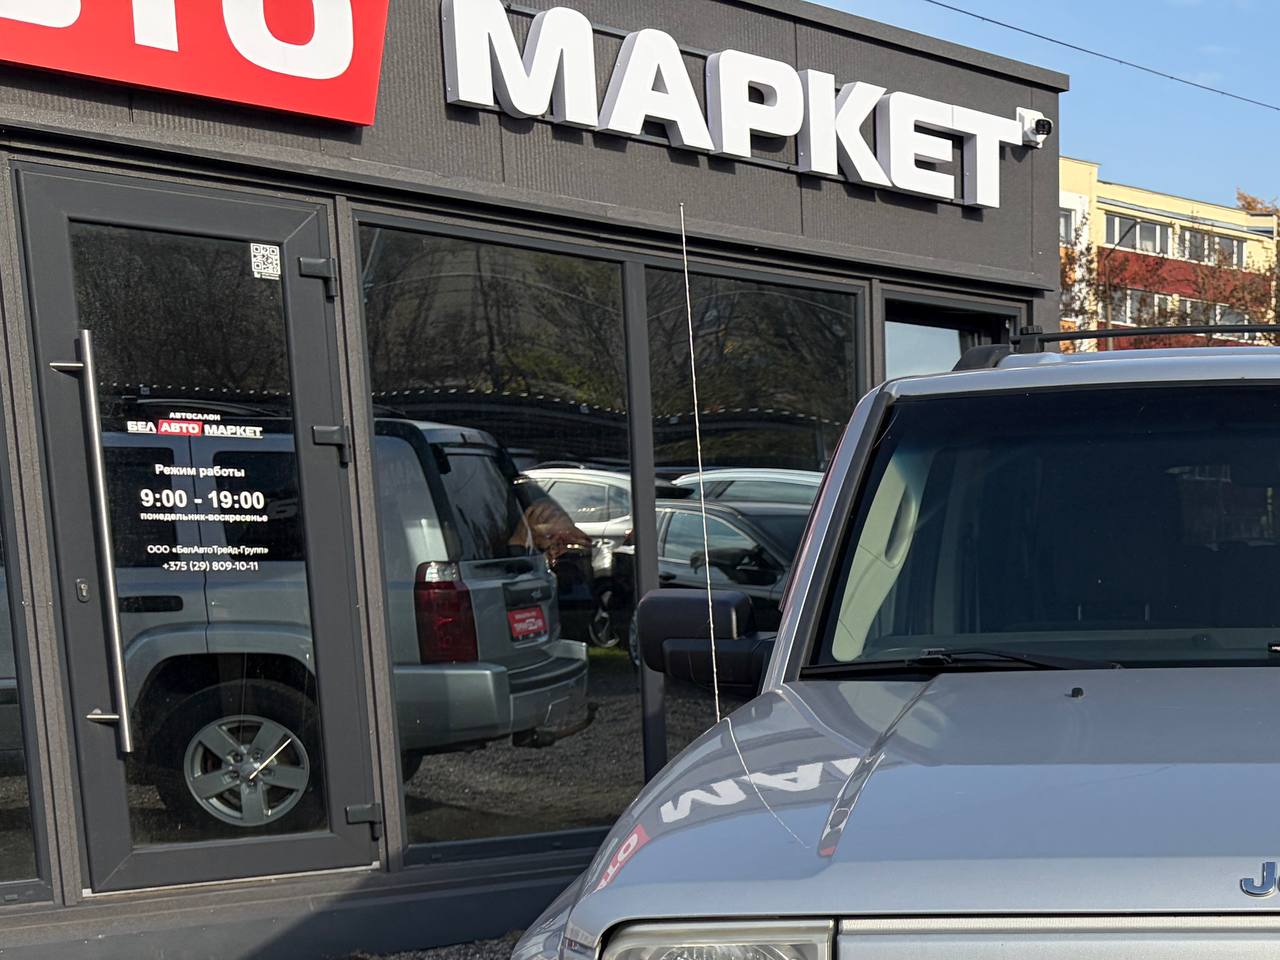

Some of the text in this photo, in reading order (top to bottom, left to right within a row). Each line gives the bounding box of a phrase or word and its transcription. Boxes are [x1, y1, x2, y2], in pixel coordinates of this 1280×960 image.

[441, 0, 1023, 208] МАРКЕТ
[169, 412, 221, 421] АВТОСАЛОН
[127, 421, 263, 438] БЕЛ АВТО МАРКЕТ
[155, 463, 246, 478] Режим работы
[140, 488, 187, 508] 9:00
[207, 490, 265, 509] 19:00
[140, 512, 269, 523] понедельник-воскресенье
[147, 544, 170, 554] ООО
[162, 560, 259, 571] +375 (29) 809-10-11
